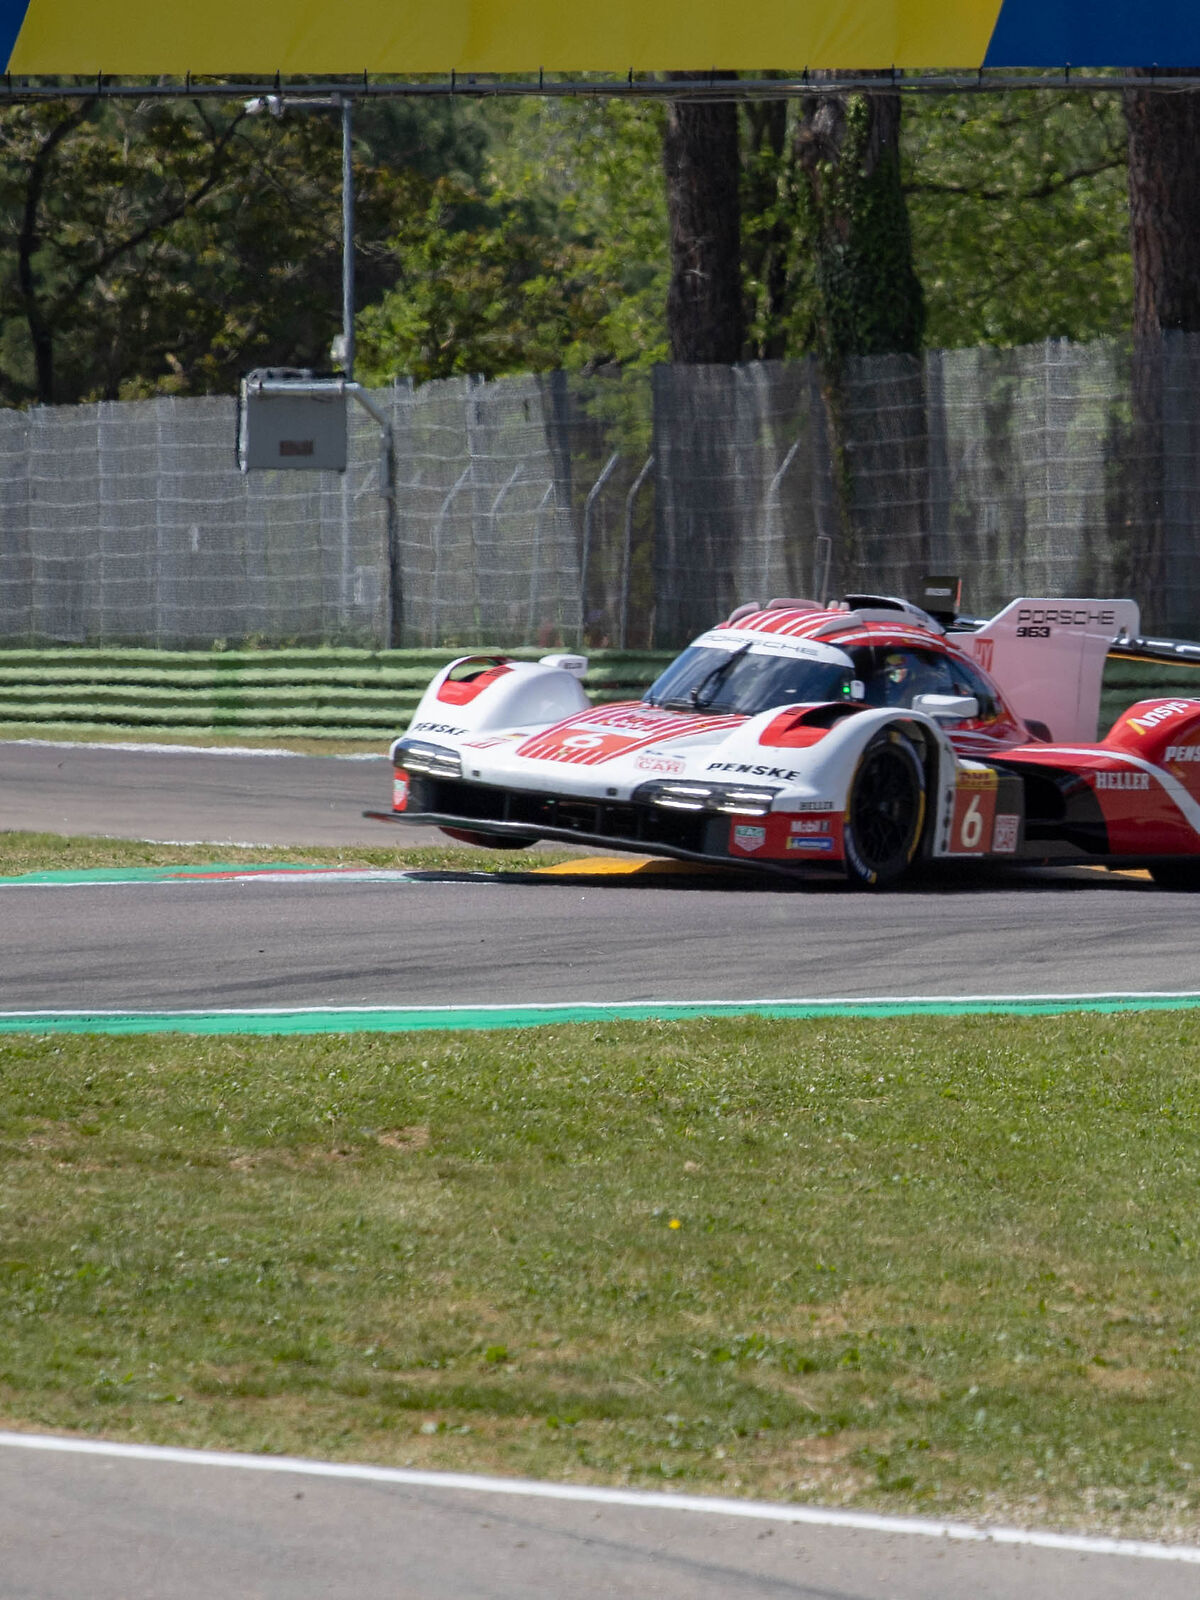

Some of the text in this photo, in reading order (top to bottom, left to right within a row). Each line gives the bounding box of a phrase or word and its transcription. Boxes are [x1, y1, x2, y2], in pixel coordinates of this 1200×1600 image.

[1017, 609, 1115, 625] PORSCHE
[1016, 626, 1051, 638] 963
[1126, 701, 1189, 735] Ansys
[562, 733, 609, 748] 6
[706, 762, 801, 781] PENSKE
[1096, 771, 1149, 790] HELLER
[961, 794, 983, 848] 6
